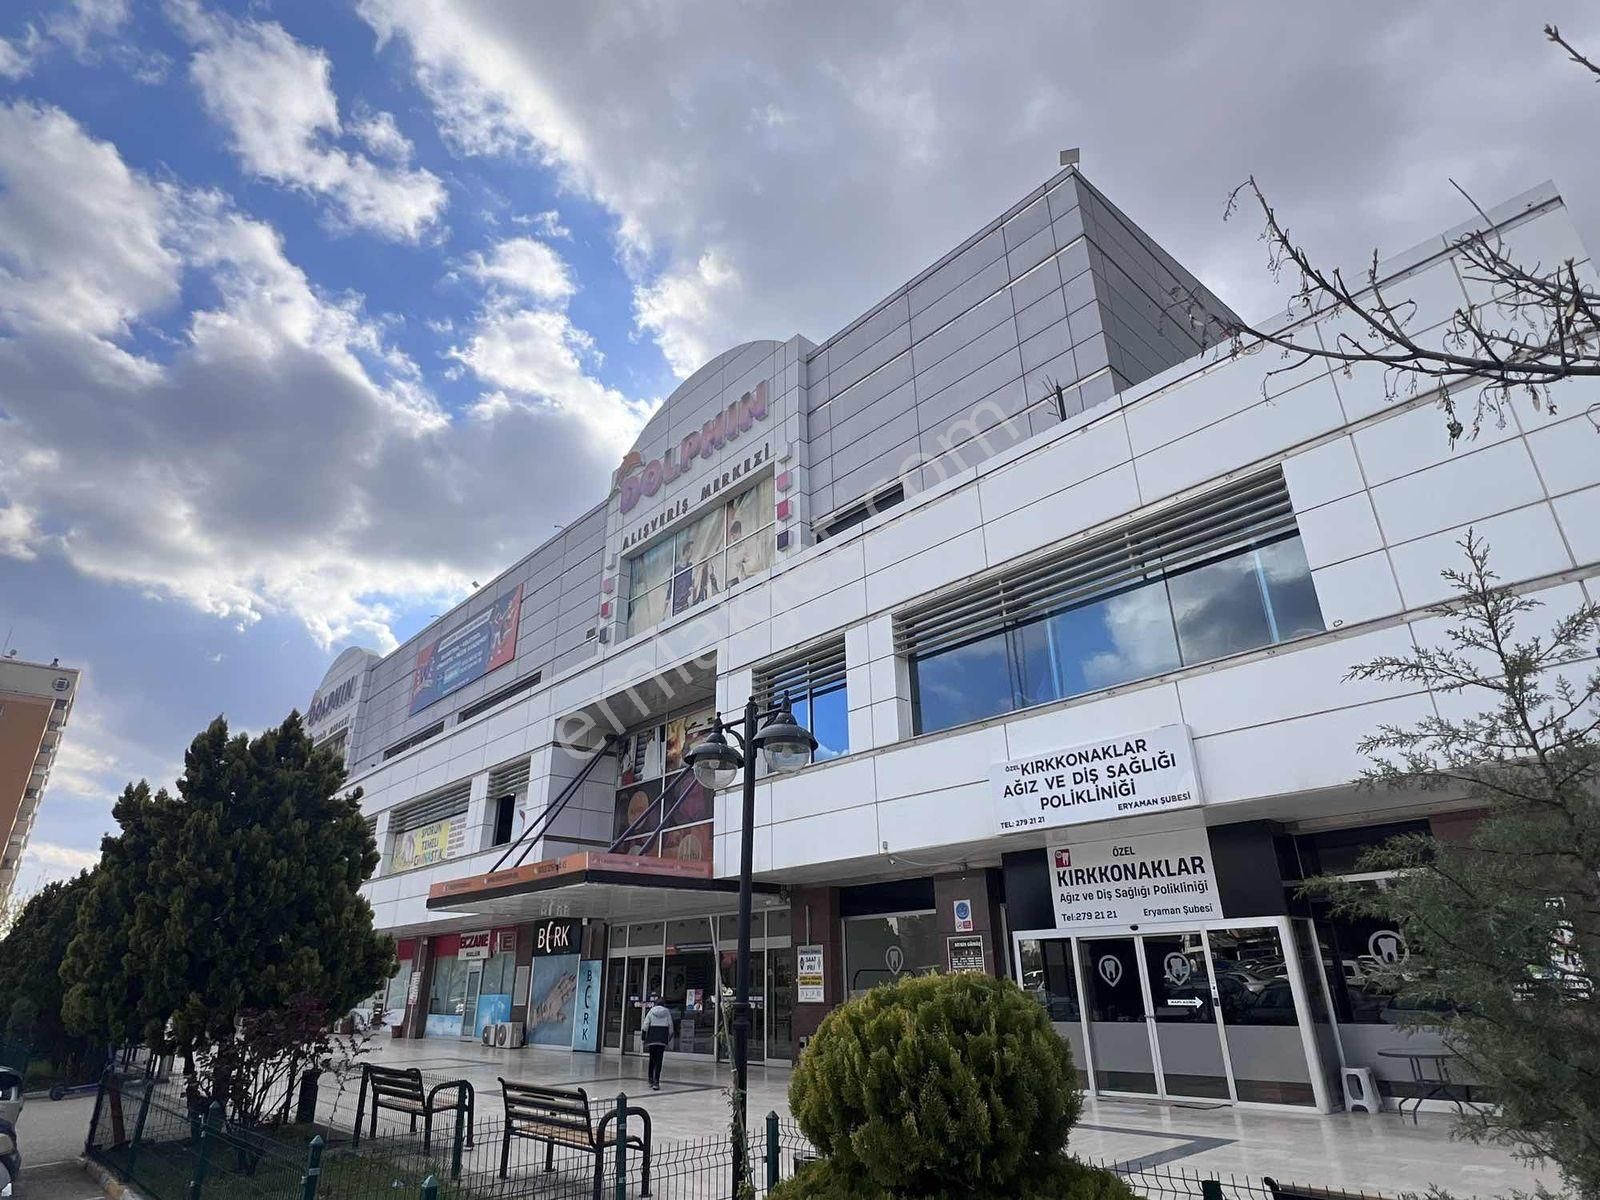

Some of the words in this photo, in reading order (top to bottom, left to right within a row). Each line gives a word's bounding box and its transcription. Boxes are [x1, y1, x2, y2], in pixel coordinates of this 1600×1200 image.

[619, 379, 769, 514] DOLPHIN
[622, 497, 689, 551] ALIŞVERİŞ
[700, 443, 771, 502] MERKEZİ
[1005, 764, 1020, 773] ÖZEL
[1020, 738, 1148, 776] KIRKKONAKLAR
[1003, 779, 1039, 798] AĞIZ
[1045, 775, 1066, 790] VE
[1073, 767, 1099, 785] DİŞ
[1107, 751, 1177, 779] SAĞLIĞI
[1040, 779, 1136, 810] POLİKLİNİĞİ
[1118, 798, 1159, 811] ERYAMAN
[1160, 791, 1192, 806] ŞUBESİ
[1015, 818, 1028, 827] 279
[1029, 817, 1037, 825] 21
[1038, 816, 1045, 824] 21
[1112, 846, 1136, 857] ÖZEL
[1057, 856, 1206, 888] KIRKKONAKLAR
[1060, 892, 1080, 904] Ağız
[1082, 891, 1094, 900] ve
[1096, 888, 1113, 901] Diş
[1115, 884, 1151, 900] Sağlığı
[1153, 879, 1209, 896] Polikliniği
[1095, 911, 1105, 920] 21
[1107, 910, 1118, 919] 21
[1143, 905, 1181, 918] Eryaman
[1183, 902, 1214, 916] Şubesi
